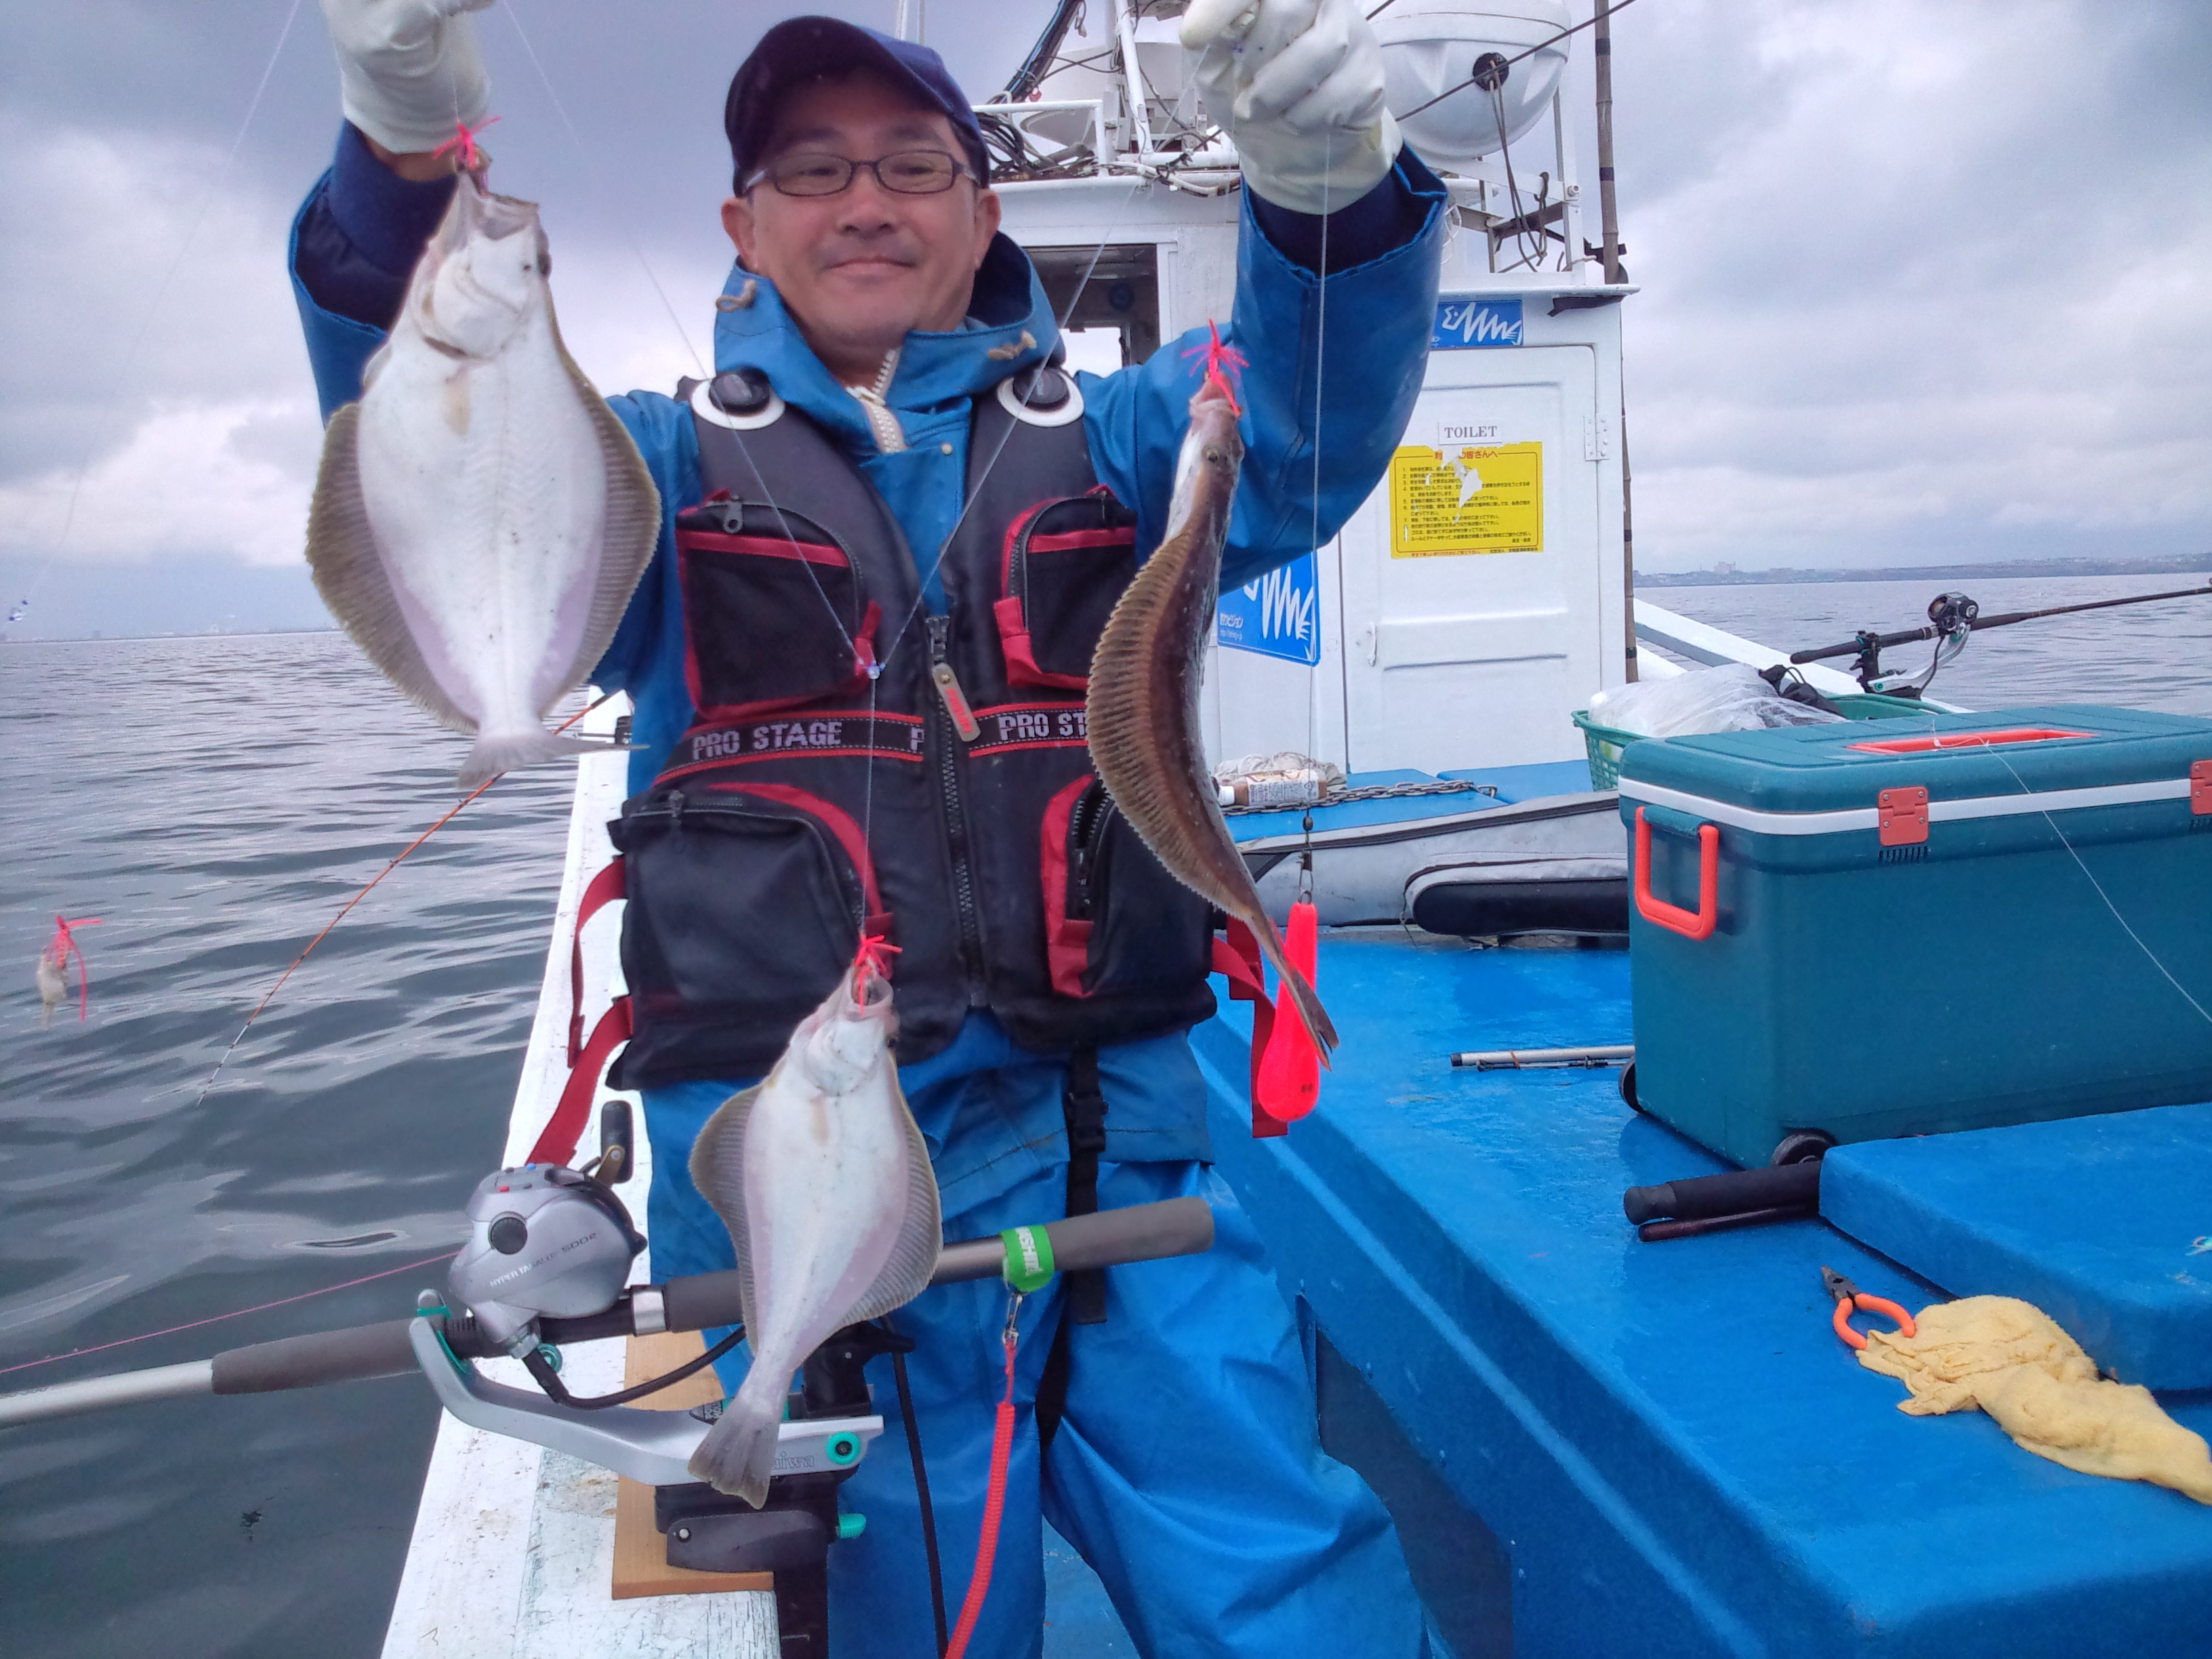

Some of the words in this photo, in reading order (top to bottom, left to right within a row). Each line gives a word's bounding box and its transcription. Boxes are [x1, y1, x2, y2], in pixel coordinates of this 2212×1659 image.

[1444, 426, 1498, 438] TOILET
[999, 713, 1050, 741] PRO
[693, 731, 740, 760] PRO
[754, 721, 842, 750] STAGE
[489, 1271, 519, 1288] HYPER
[773, 1451, 815, 1471] aiwa
